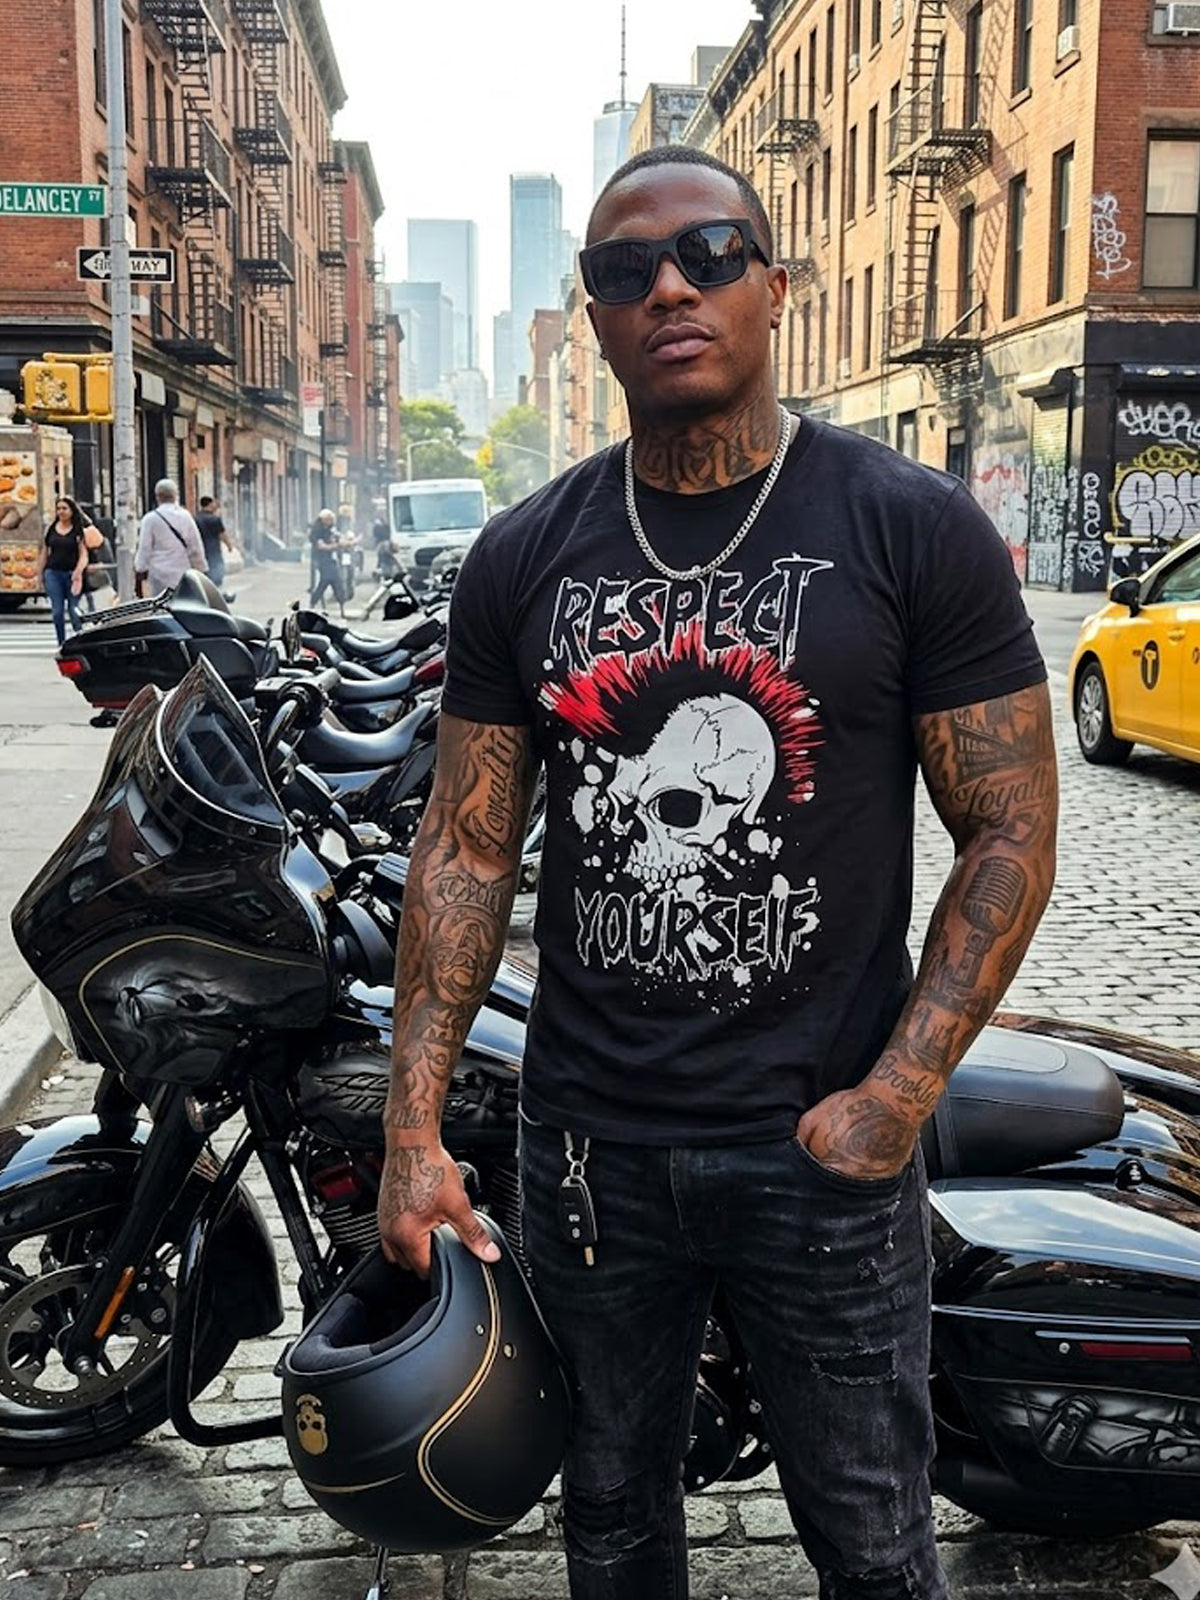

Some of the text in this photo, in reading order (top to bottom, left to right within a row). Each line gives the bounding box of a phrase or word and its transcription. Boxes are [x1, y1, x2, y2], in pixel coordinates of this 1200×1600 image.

[0, 187, 82, 213] ELANCEY
[131, 260, 160, 272] WAY
[549, 552, 834, 672] RESPECT
